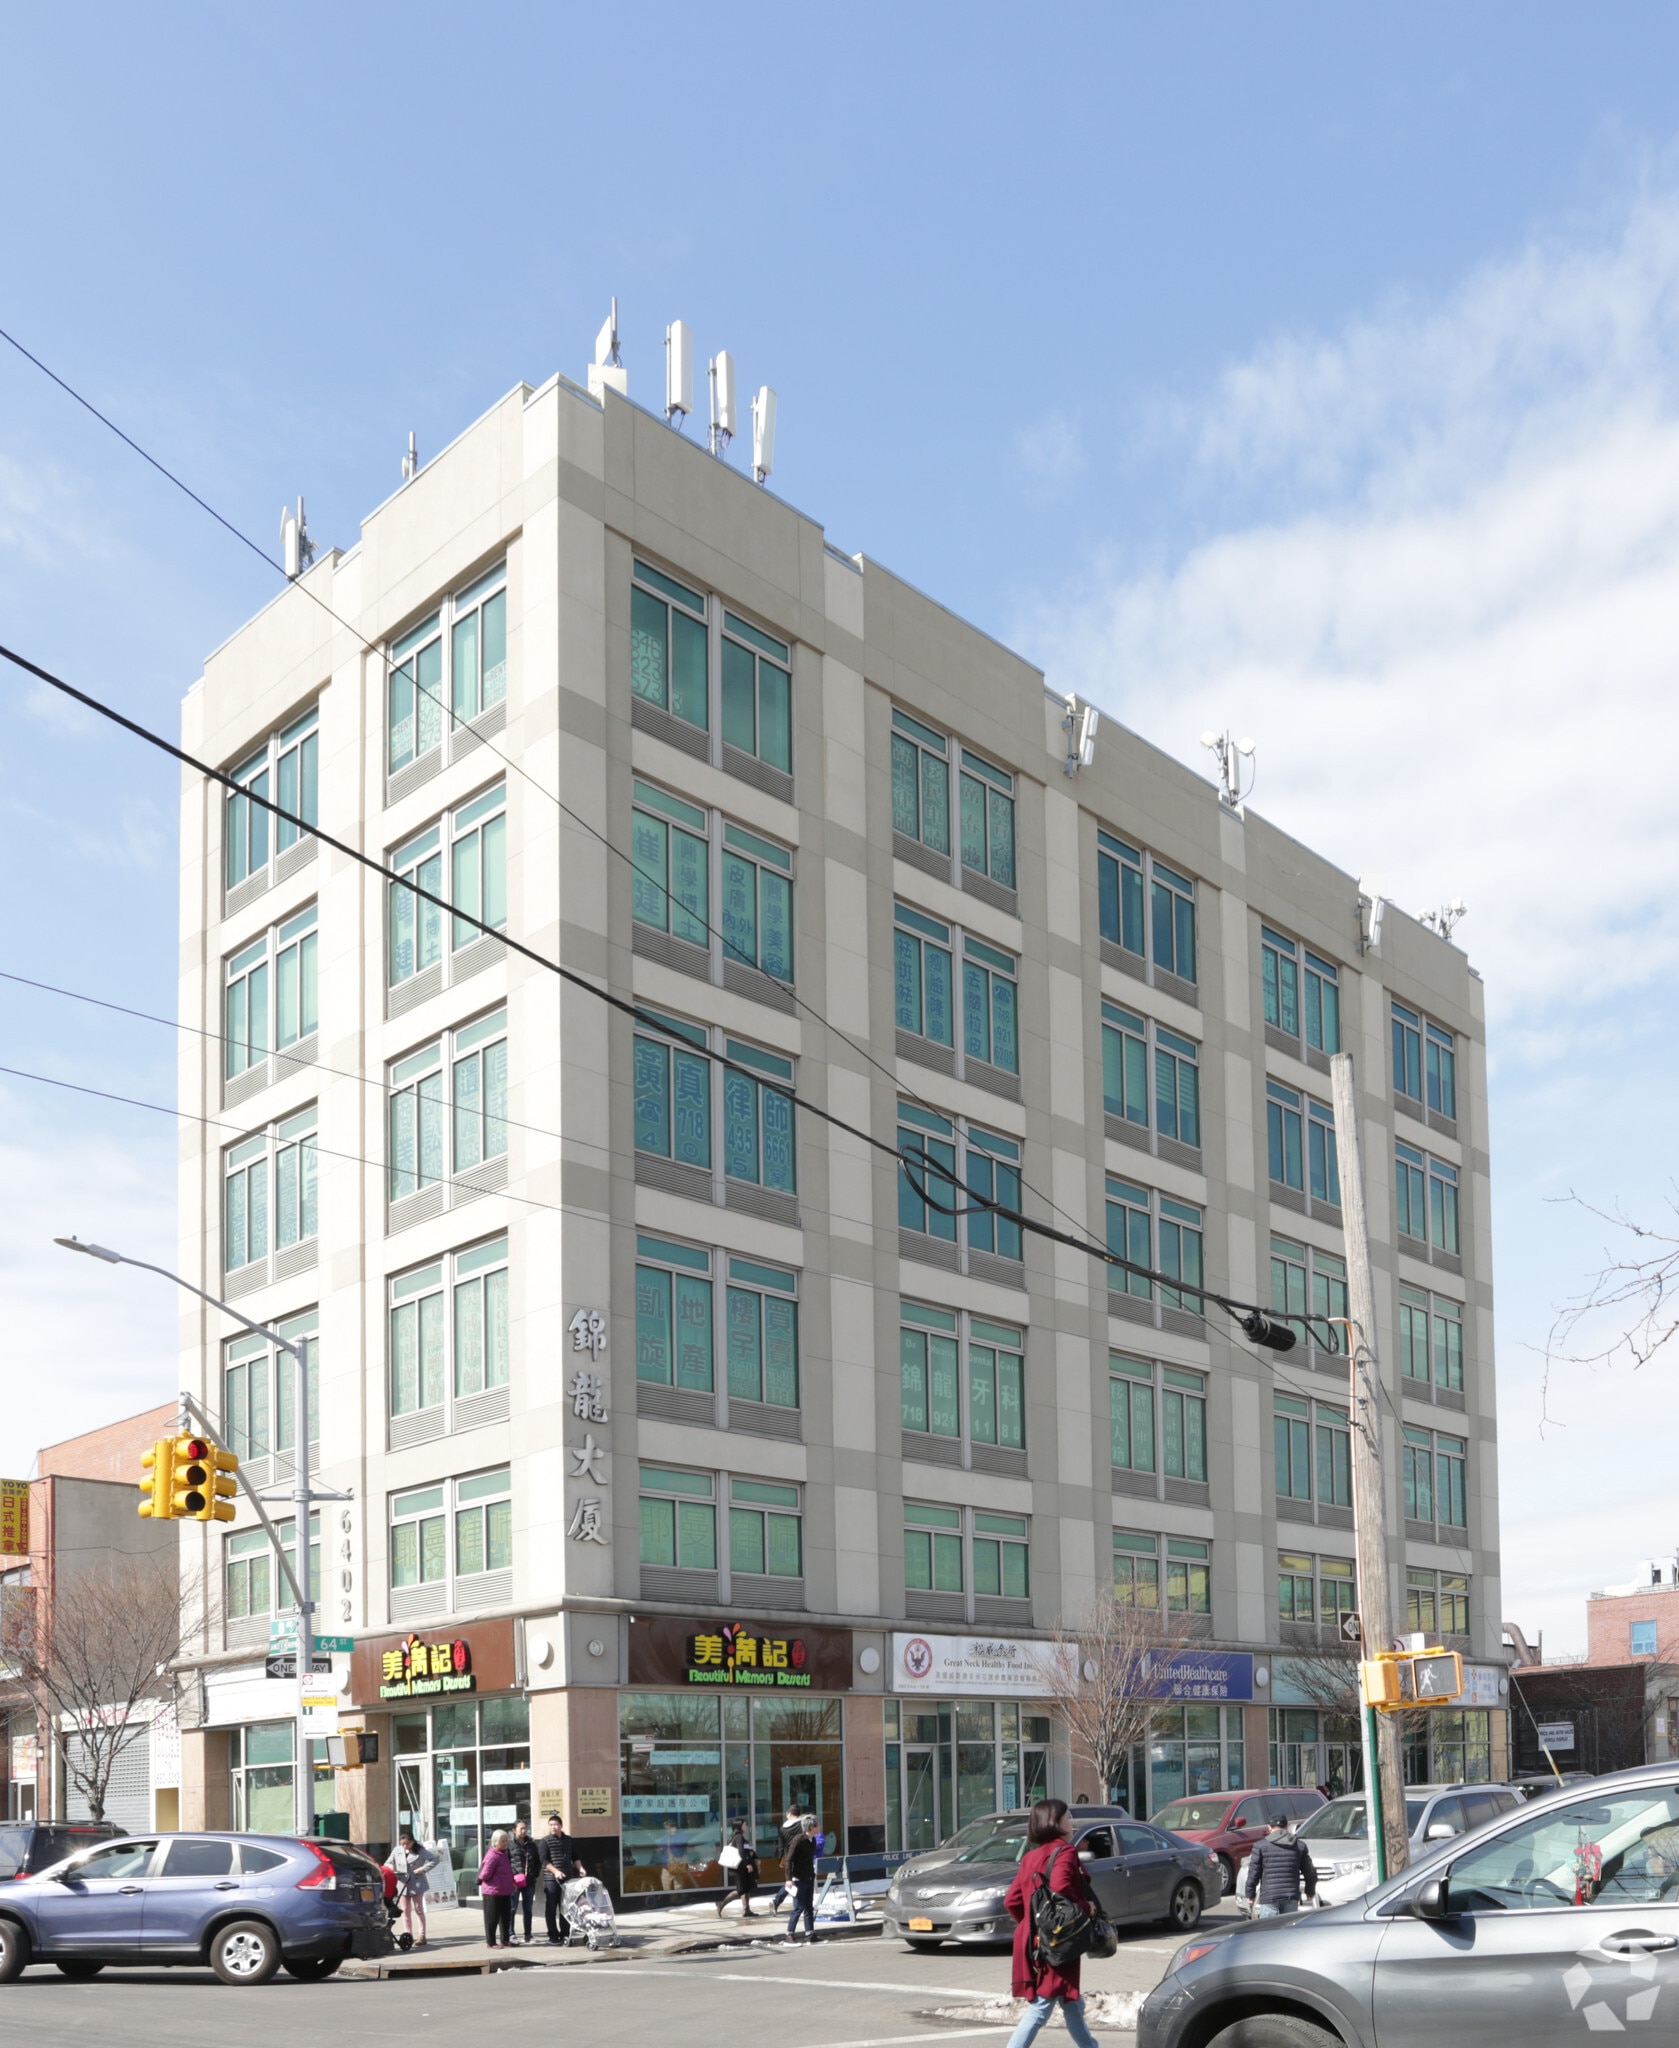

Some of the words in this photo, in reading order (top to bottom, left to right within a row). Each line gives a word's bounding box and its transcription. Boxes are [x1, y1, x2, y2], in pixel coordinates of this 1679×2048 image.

[766, 877, 784, 978] 醫學美容
[678, 1105, 704, 1140] 718
[727, 1123, 752, 1154] 435
[765, 1135, 790, 1167] 6661
[902, 1404, 923, 1424] 718
[933, 1409, 955, 1428] 921
[2, 1496, 15, 1552] 日式推拿
[320, 1638, 337, 1650] 64
[273, 1663, 295, 1672] ONE
[943, 1658, 963, 1669] Great
[964, 1659, 980, 1670] Neck
[981, 1660, 1006, 1672] Healthy
[1007, 1662, 1022, 1672] Food
[1154, 1664, 1228, 1682] UnitedHealthcare
[736, 1670, 774, 1685] Memory
[777, 1671, 811, 1687] Desserts
[412, 1680, 442, 1696] Memory
[883, 1853, 899, 1862] POLICE
